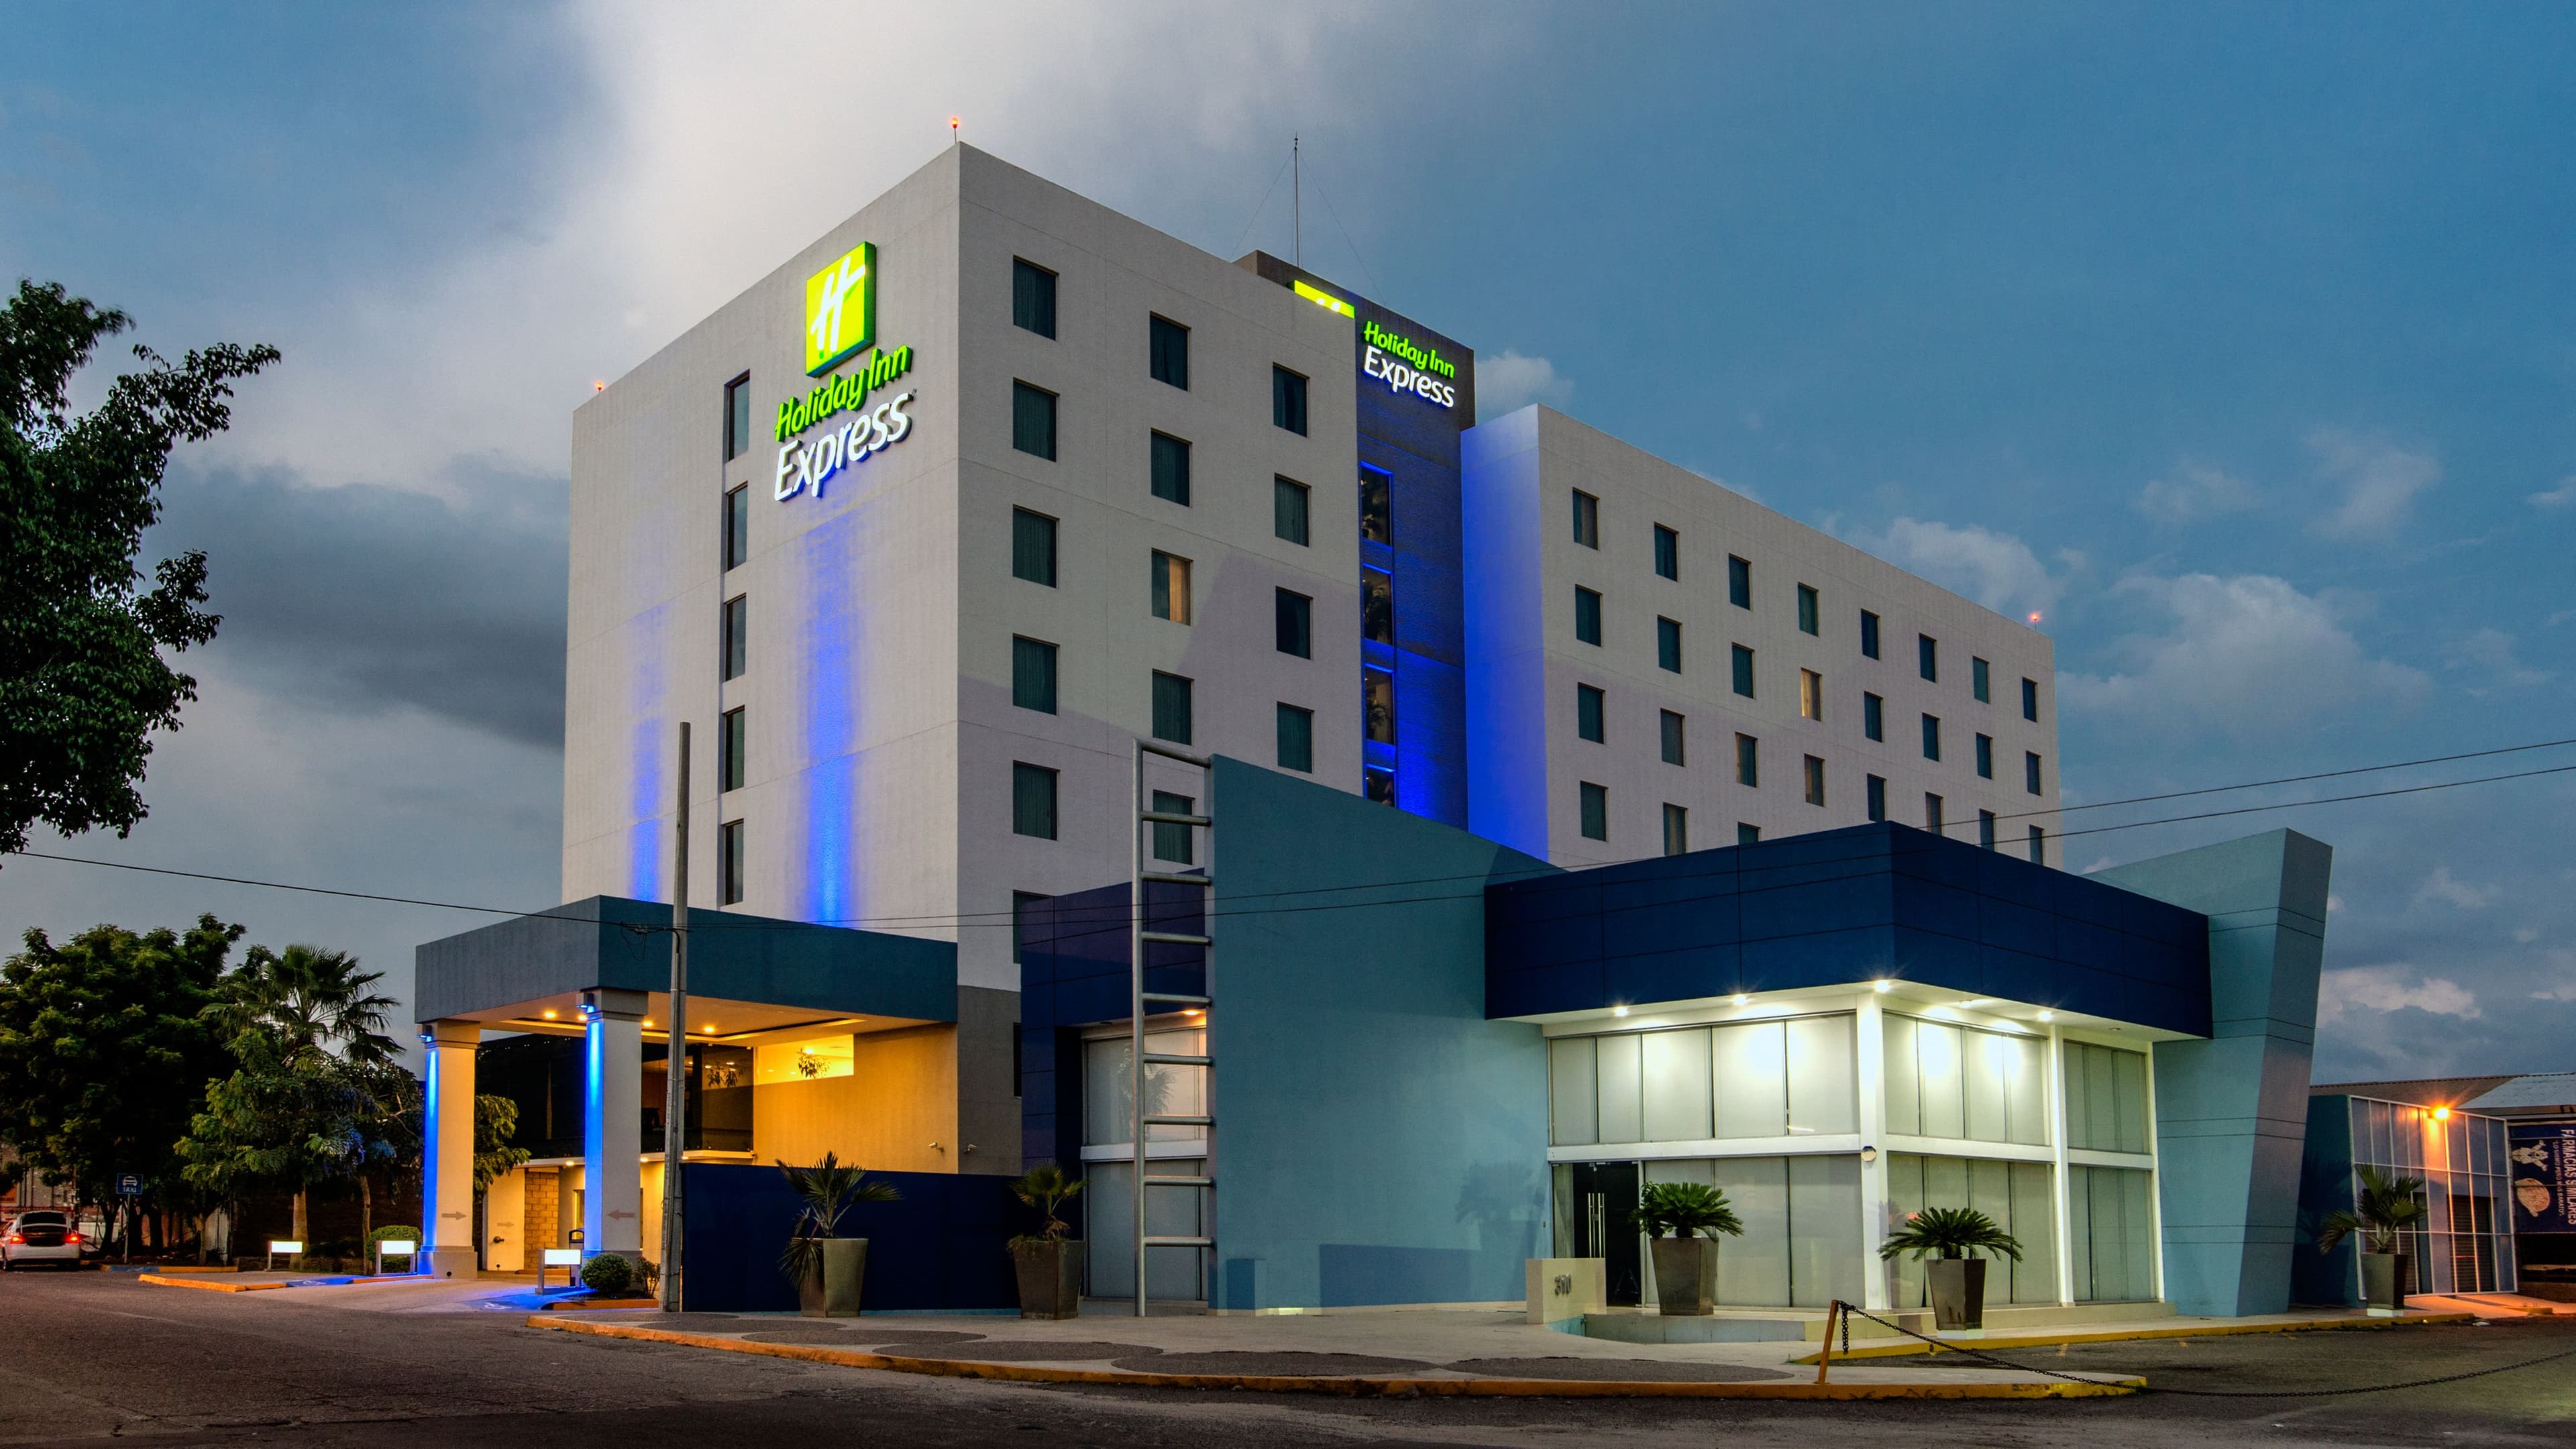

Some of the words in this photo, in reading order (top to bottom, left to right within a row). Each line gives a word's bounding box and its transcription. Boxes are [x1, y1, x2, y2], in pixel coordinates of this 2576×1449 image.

[1364, 321, 1428, 370] Holiday
[1430, 350, 1454, 378] Inn
[1364, 345, 1454, 407] Express
[775, 368, 869, 442] Holiday
[867, 345, 912, 390] Inn
[774, 392, 911, 501] Express
[2561, 1129, 2576, 1177] FARMACIAS
[2565, 1179, 2576, 1224] SMILARES
